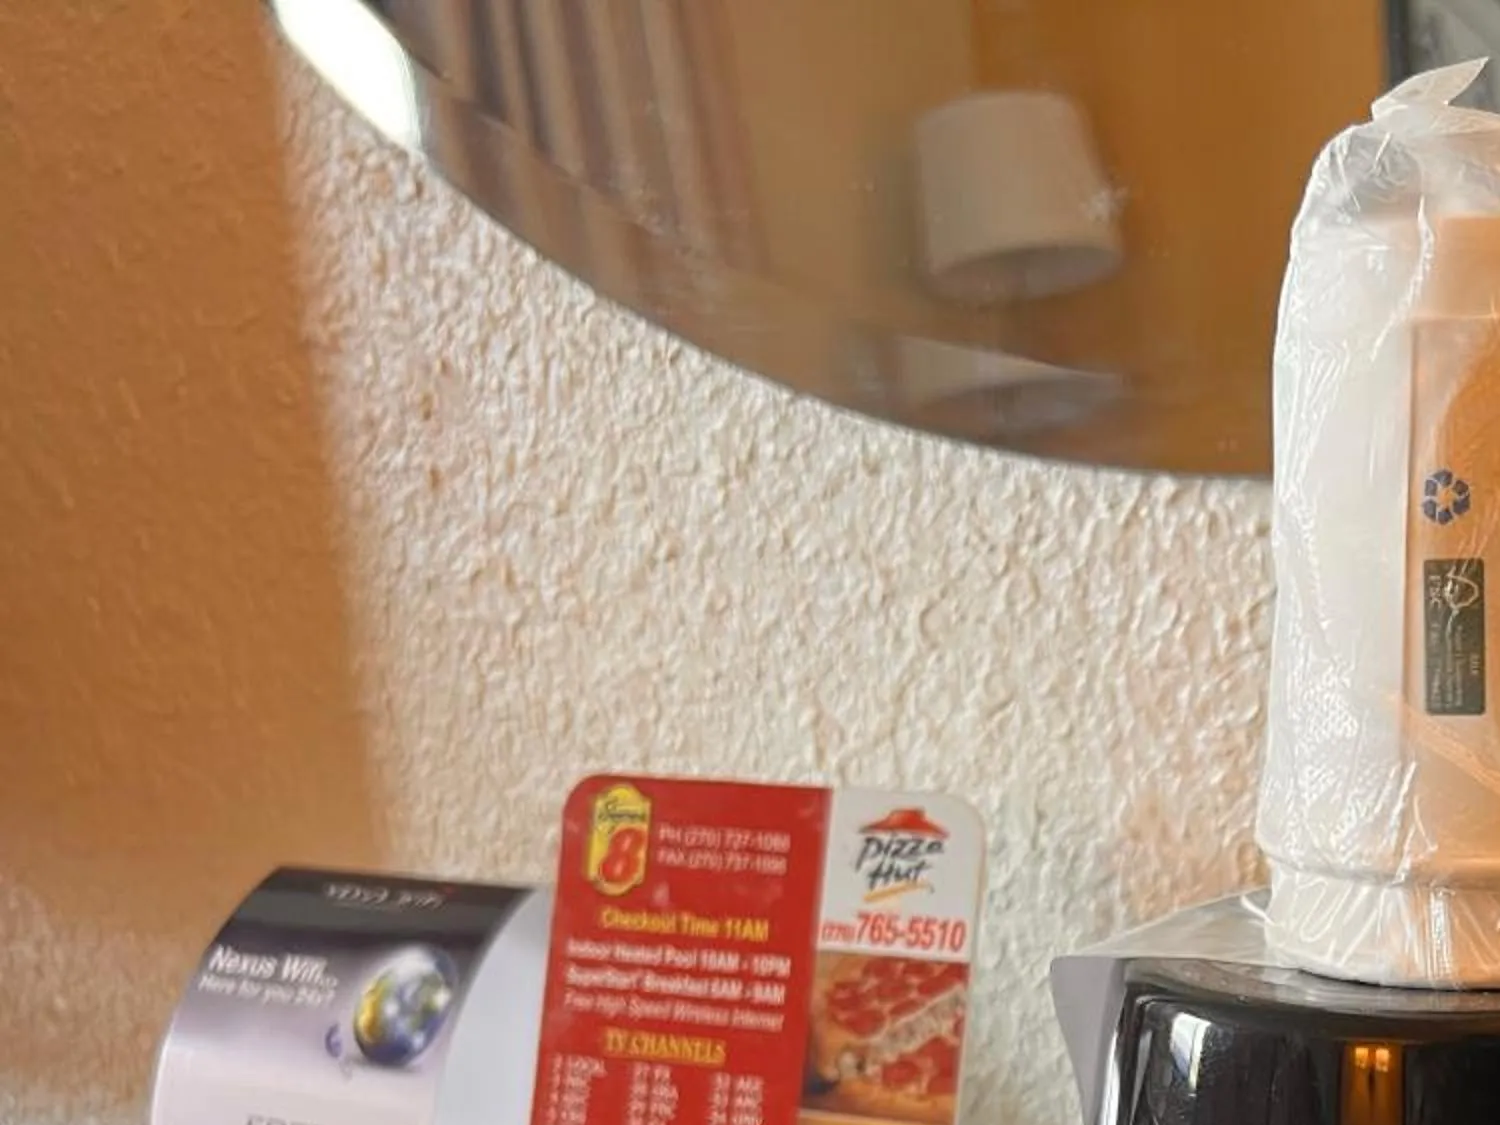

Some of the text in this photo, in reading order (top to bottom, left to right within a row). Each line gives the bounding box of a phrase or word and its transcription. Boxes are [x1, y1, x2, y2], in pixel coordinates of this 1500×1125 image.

[855, 833, 945, 873] Pizza
[867, 861, 933, 892] Hut
[601, 906, 769, 943] Checkout Time 11AM
[856, 911, 968, 953] 765-5510
[206, 944, 279, 980] Nexus
[607, 1026, 727, 1066] TV CHANNELS
